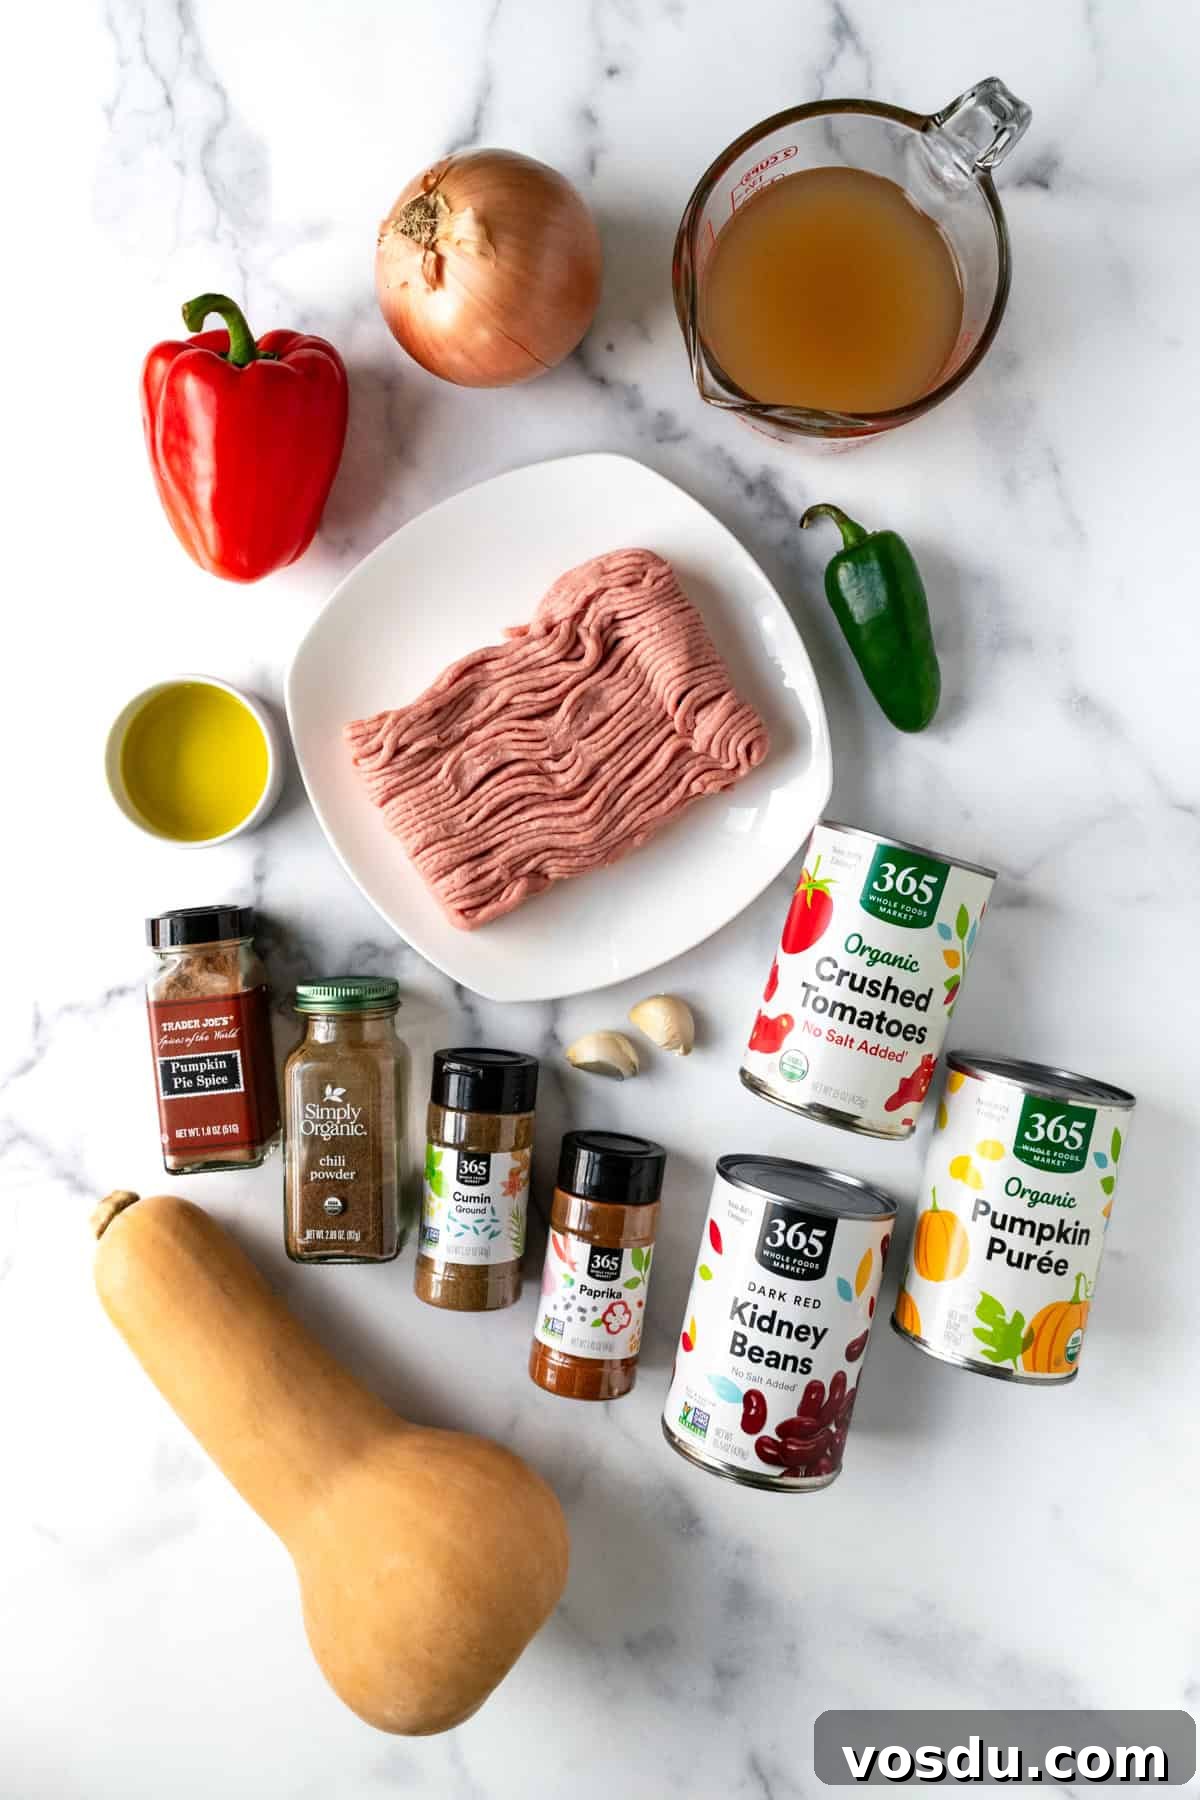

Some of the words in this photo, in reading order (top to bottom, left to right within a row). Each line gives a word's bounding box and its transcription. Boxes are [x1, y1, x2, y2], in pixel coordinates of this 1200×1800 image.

[872, 862, 939, 905] 365
[869, 895, 899, 909] WHOLE
[900, 903, 928, 918] FOODS
[879, 906, 914, 921] MARKET
[844, 933, 920, 973] Organic
[815, 956, 934, 1012] Crushed
[801, 982, 928, 1044] Tomatoes
[161, 1019, 201, 1032] TRADER
[802, 1021, 822, 1037] No
[825, 1029, 855, 1049] Salt
[170, 1058, 227, 1074] Pumpkin
[173, 1076, 193, 1089] Pie
[196, 1073, 229, 1089] Spice
[305, 1103, 362, 1125] Simply
[1024, 1113, 1087, 1150] 365
[320, 1155, 345, 1167] chili
[1022, 1144, 1051, 1157] WHOLE
[1053, 1150, 1080, 1162] FOODS
[1033, 1155, 1066, 1167] MARKET
[310, 1168, 356, 1181] powder
[459, 1160, 487, 1176] 365
[453, 1192, 491, 1205] Cumin
[1004, 1177, 1077, 1208] Organic
[456, 1204, 487, 1215] Ground
[971, 1198, 1090, 1247] Pumpkin
[766, 1218, 827, 1258] 365
[591, 1254, 620, 1271] 365
[763, 1249, 791, 1264] WHOLE
[792, 1257, 820, 1270] FOODS
[986, 1237, 1069, 1276] Purée
[773, 1260, 806, 1275] MARKET
[579, 1284, 623, 1300] Paprika
[748, 1281, 788, 1302] DARK
[794, 1295, 822, 1310] RED
[729, 1297, 829, 1350] Kidney
[729, 1331, 814, 1376] Beans
[731, 1367, 746, 1379] No
[747, 1370, 764, 1385] Salt
